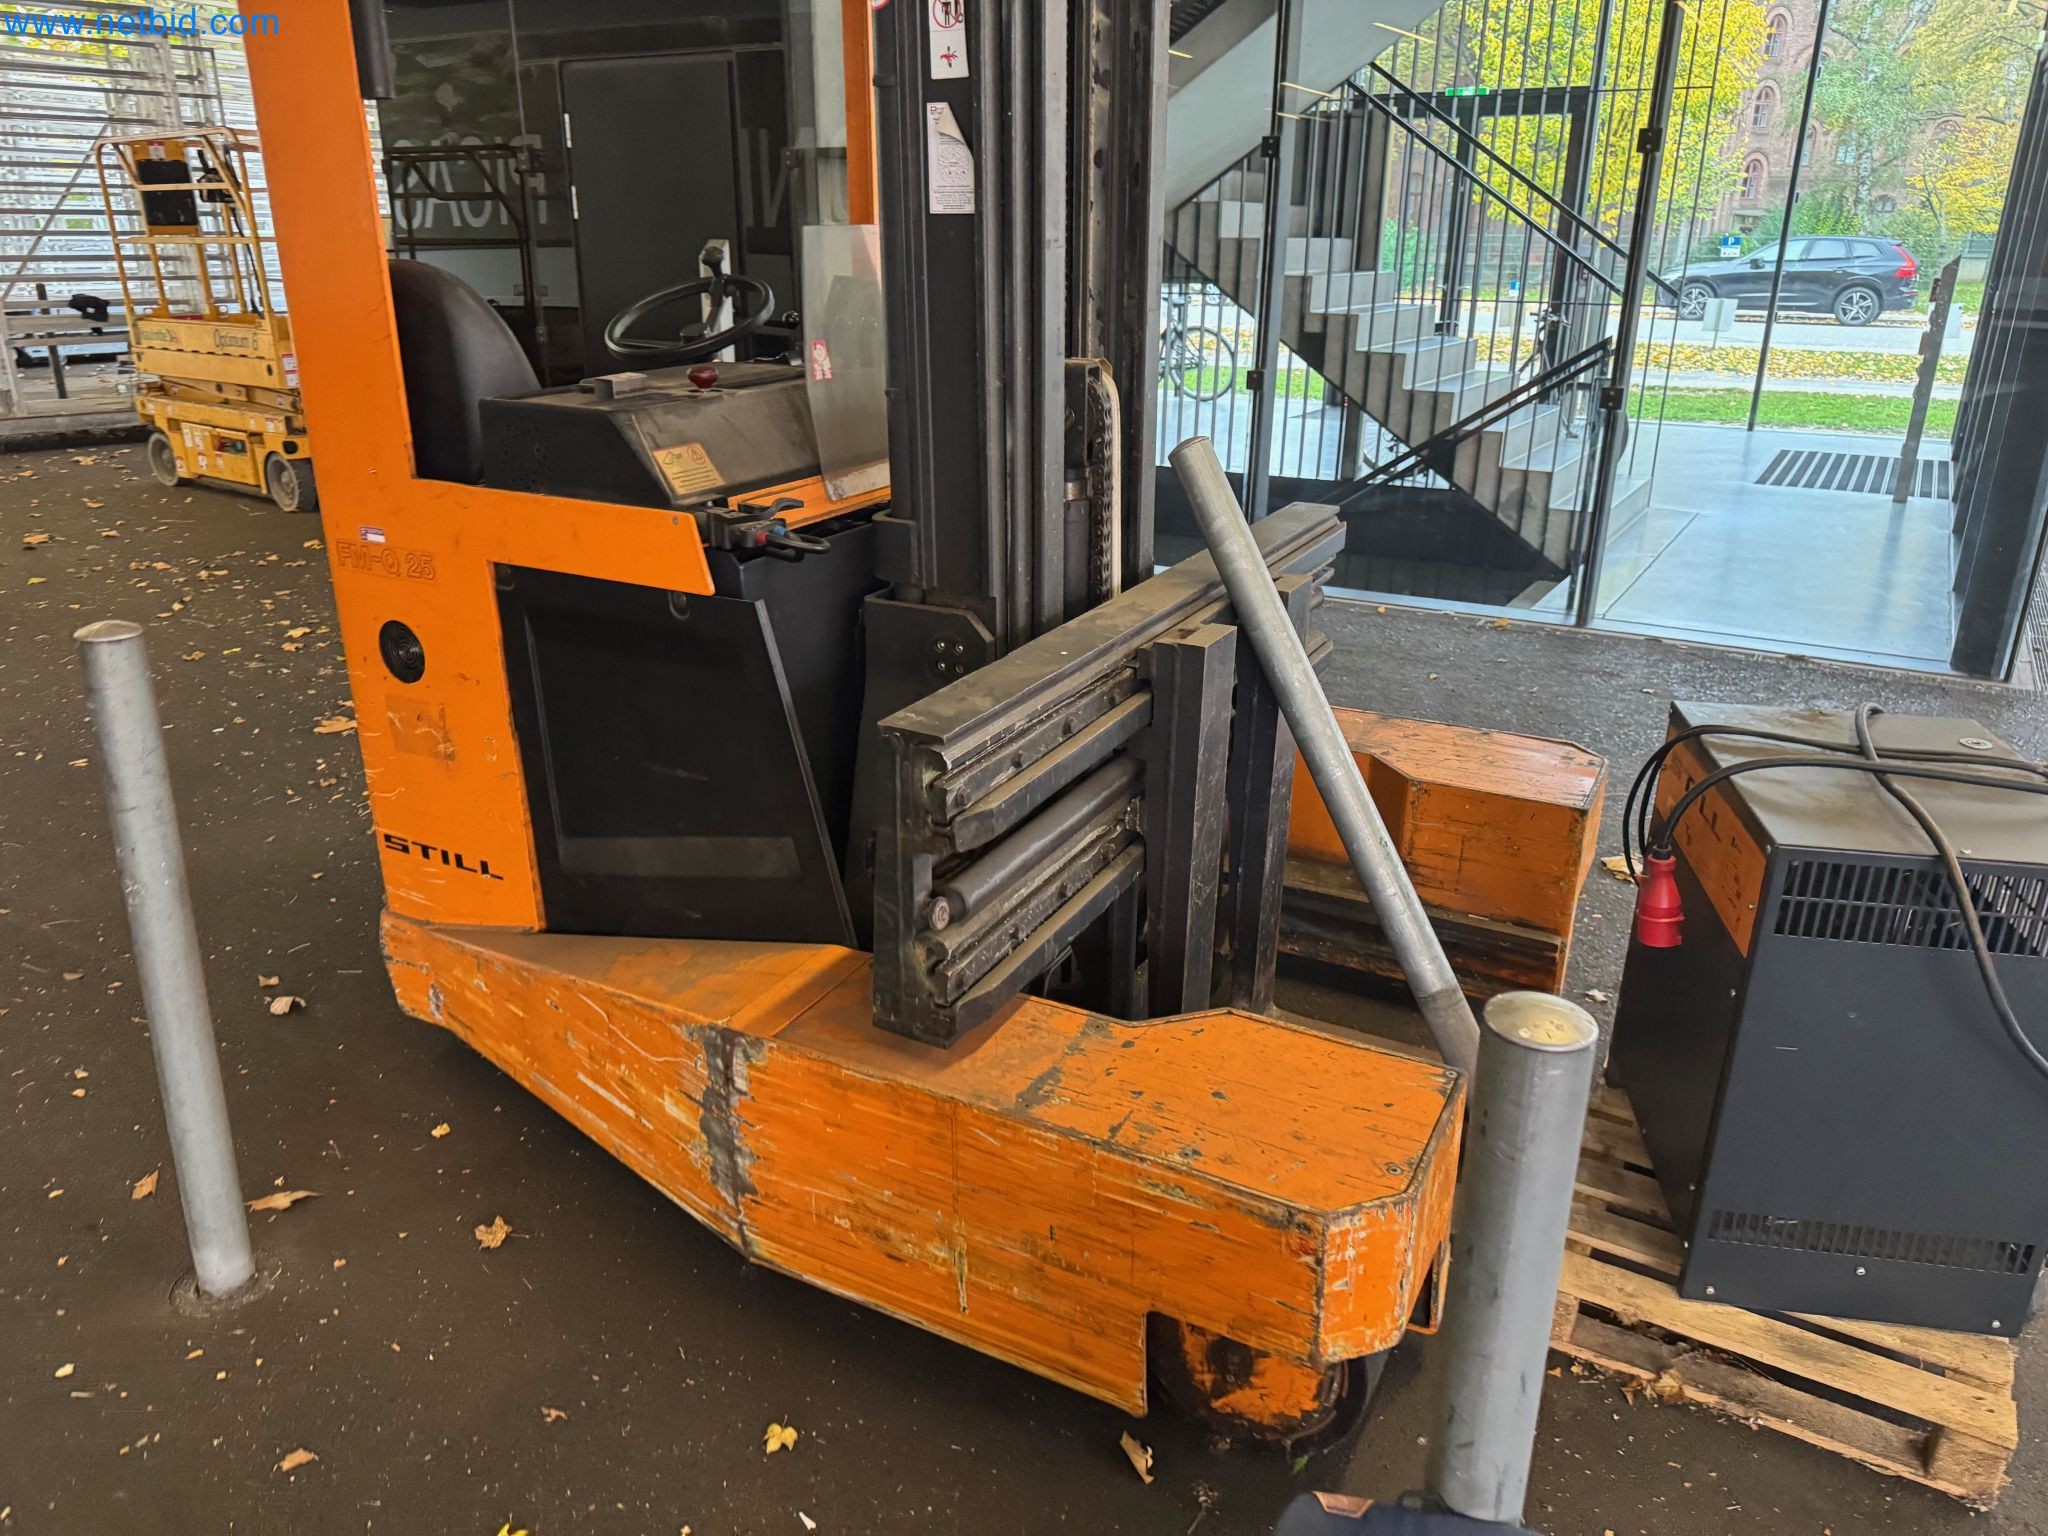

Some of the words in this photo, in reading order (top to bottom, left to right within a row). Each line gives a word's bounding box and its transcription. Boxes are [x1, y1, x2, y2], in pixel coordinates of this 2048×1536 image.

[1728, 236, 1735, 246] P
[405, 552, 435, 580] 25
[384, 833, 504, 880] STILL
